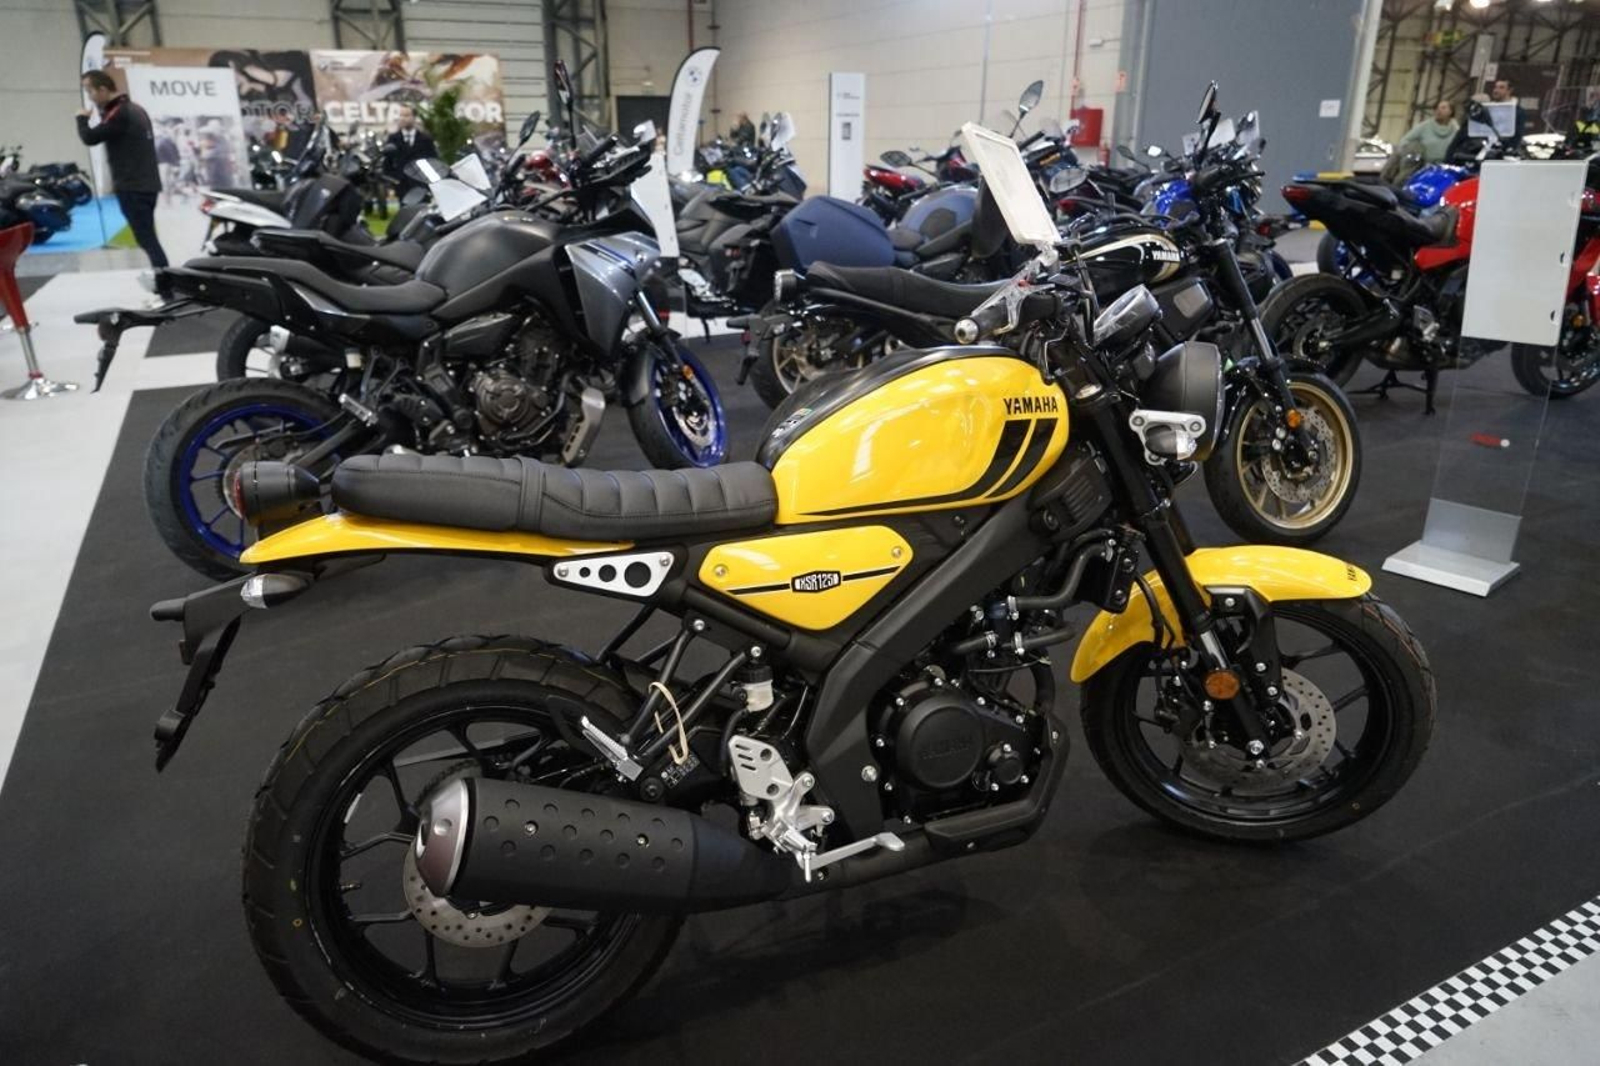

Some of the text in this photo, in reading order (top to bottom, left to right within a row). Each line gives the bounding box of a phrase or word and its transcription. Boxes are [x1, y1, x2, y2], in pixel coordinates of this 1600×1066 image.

[150, 79, 218, 97] MOVE
[1003, 396, 1058, 415] YAMAHA
[800, 572, 834, 591] XSR125
